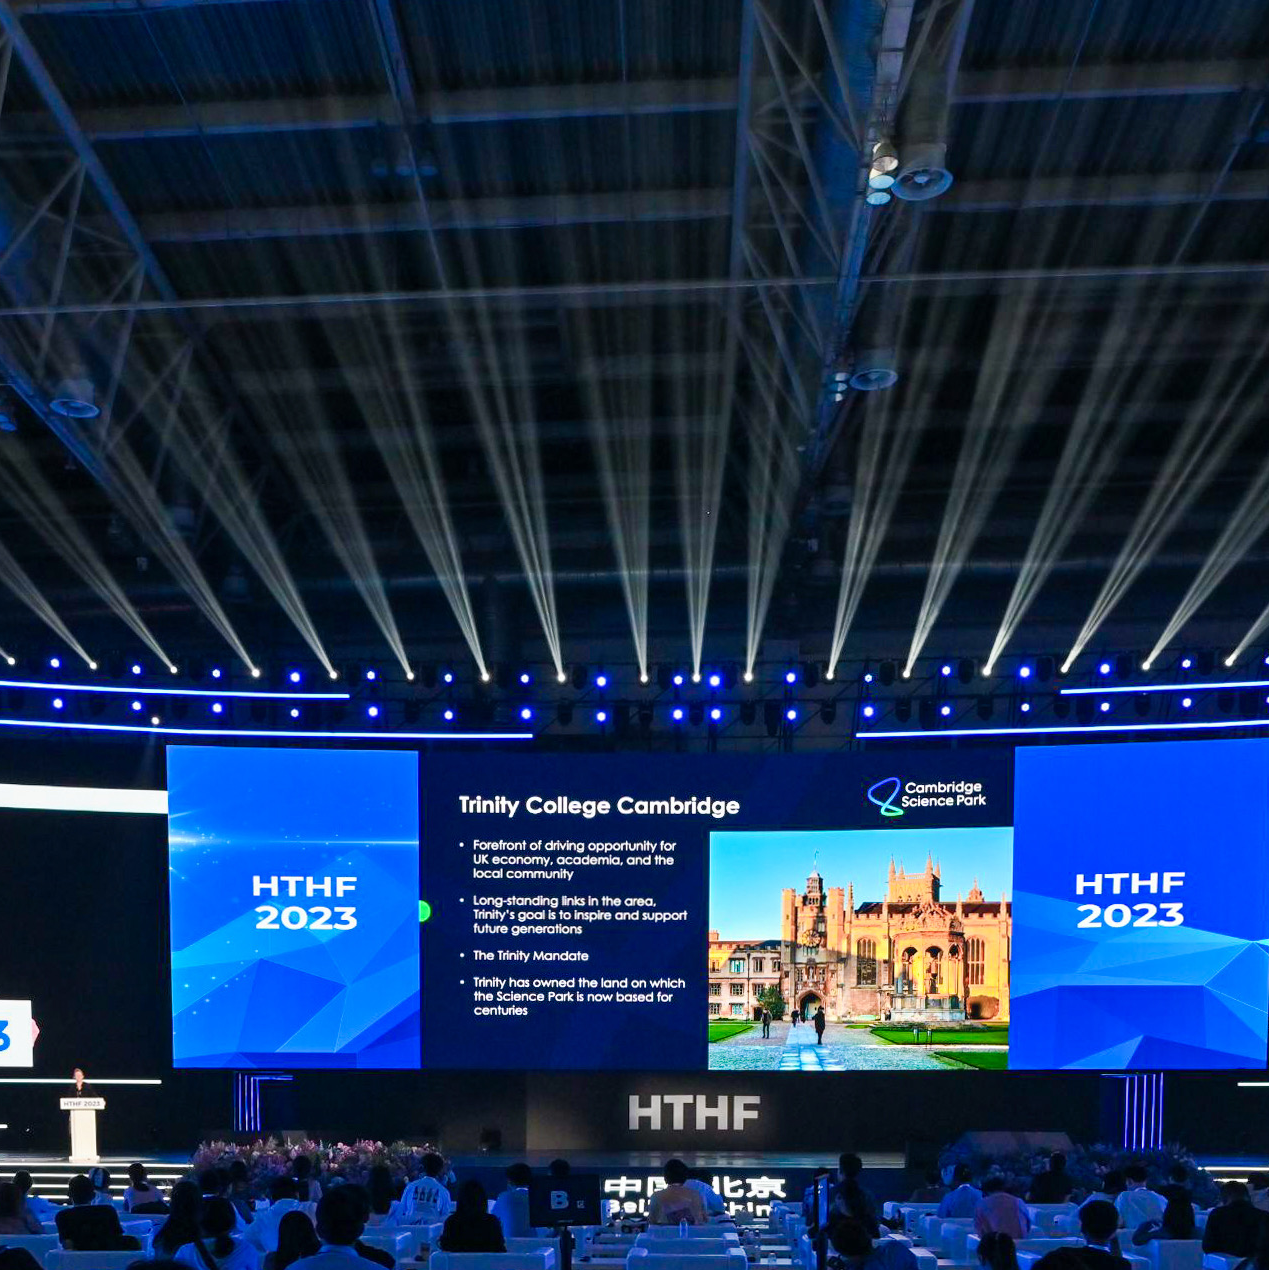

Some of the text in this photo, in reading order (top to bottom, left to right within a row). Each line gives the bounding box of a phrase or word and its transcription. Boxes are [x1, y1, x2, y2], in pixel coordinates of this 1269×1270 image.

[904, 780, 983, 795] Cambridge
[458, 795, 741, 819] Trinity College Cambridge
[901, 794, 987, 808] Science Park
[473, 839, 677, 854] Forefront of driving opportunity for
[473, 853, 675, 868] UK economy, academia, and the
[473, 867, 574, 881] local community
[252, 875, 358, 898] HTHF
[1075, 871, 1186, 895] HTHF
[473, 895, 657, 909] Long-standing links in the area,
[254, 905, 358, 931] 2023
[472, 908, 688, 923] Trinity's goal is to inspire and support
[1076, 902, 1185, 929] 2023
[473, 922, 583, 937] future generations
[472, 949, 589, 963] The Trinity Mandate
[473, 976, 686, 990] Trinity has owned the land on which
[473, 990, 674, 1003] the Science Park is now based for
[473, 1004, 529, 1016] centuries
[63, 1100, 101, 1108] HTHF 2023
[628, 1094, 761, 1131] HTHF
[551, 1191, 569, 1209] B
